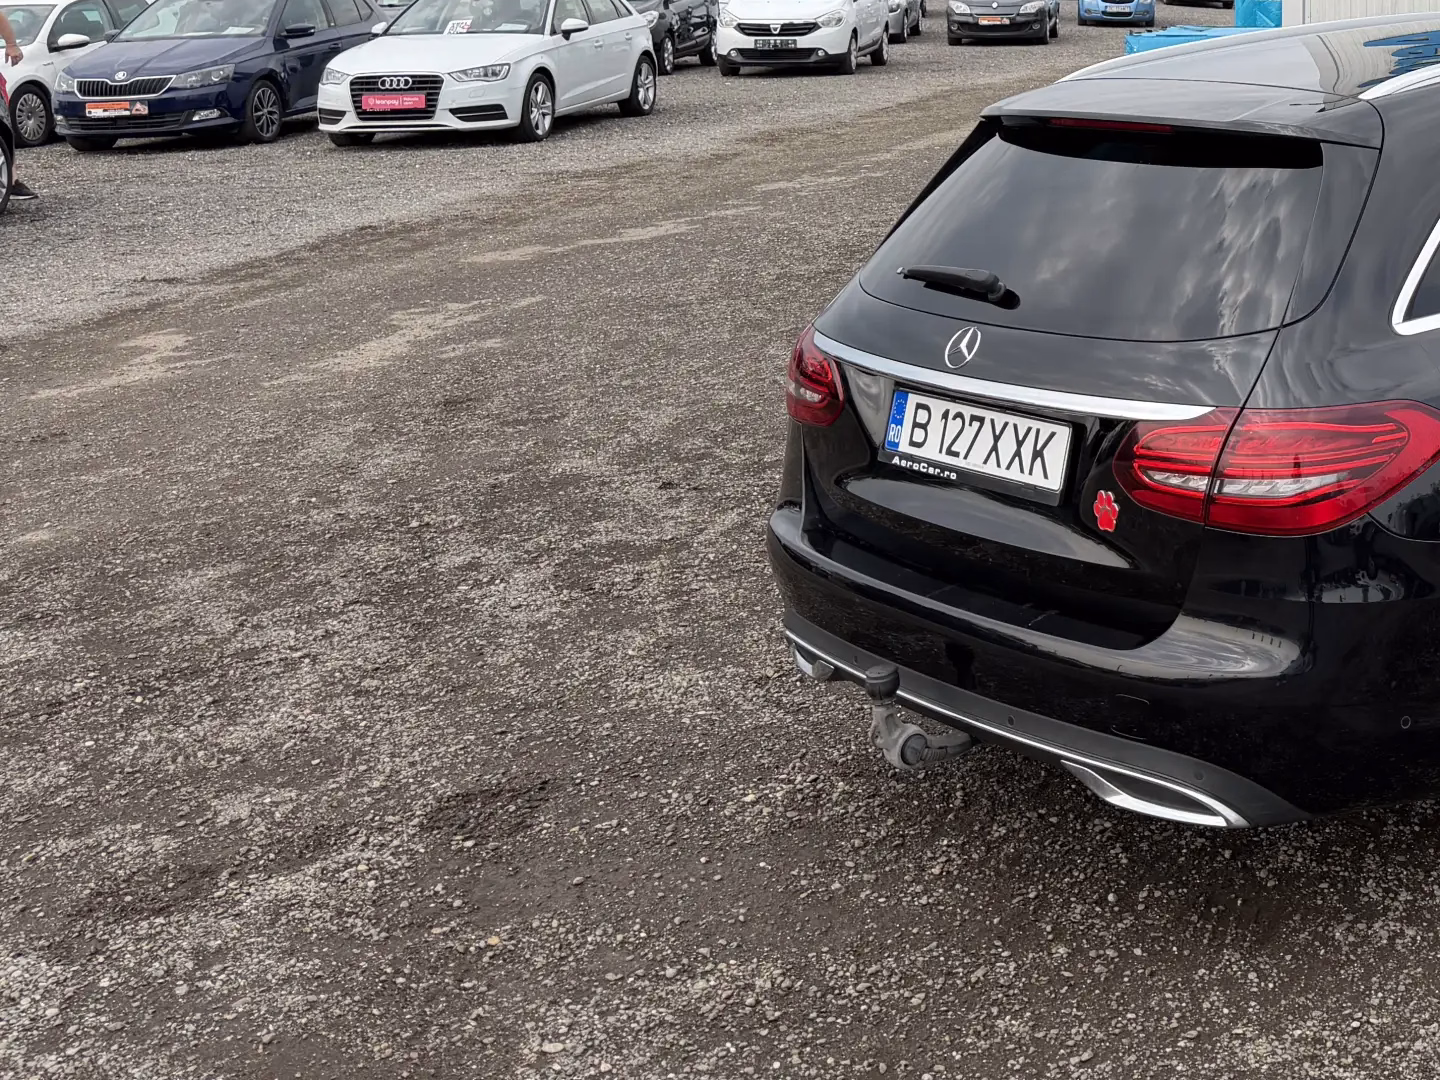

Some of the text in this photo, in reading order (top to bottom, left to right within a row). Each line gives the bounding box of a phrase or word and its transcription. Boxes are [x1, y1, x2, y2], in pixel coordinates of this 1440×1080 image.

[887, 423, 902, 443] RO
[908, 402, 932, 449] B
[891, 455, 957, 480] AeroCar.ro
